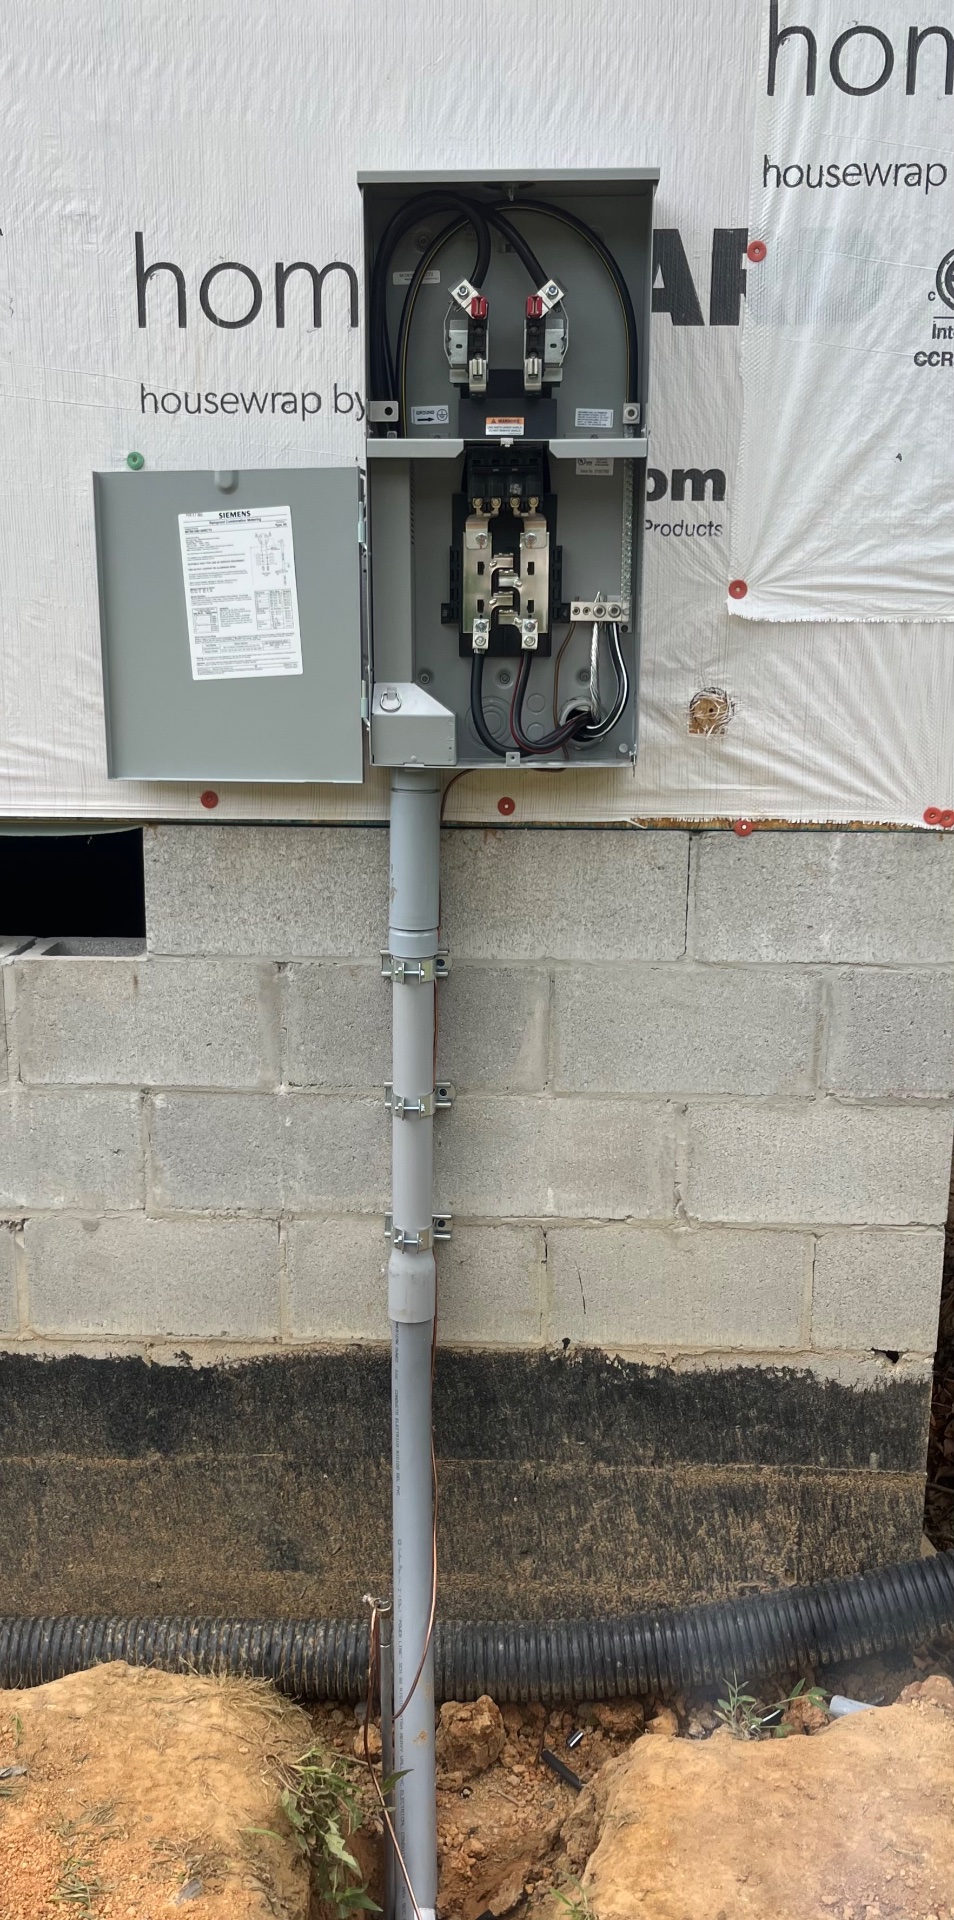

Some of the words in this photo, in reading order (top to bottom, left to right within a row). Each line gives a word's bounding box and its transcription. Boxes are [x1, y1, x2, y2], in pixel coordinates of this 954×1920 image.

[763, 154, 948, 195] housewrap
[141, 382, 322, 421] housewrap
[333, 383, 366, 421] by
[218, 510, 252, 519] SIEMENS
